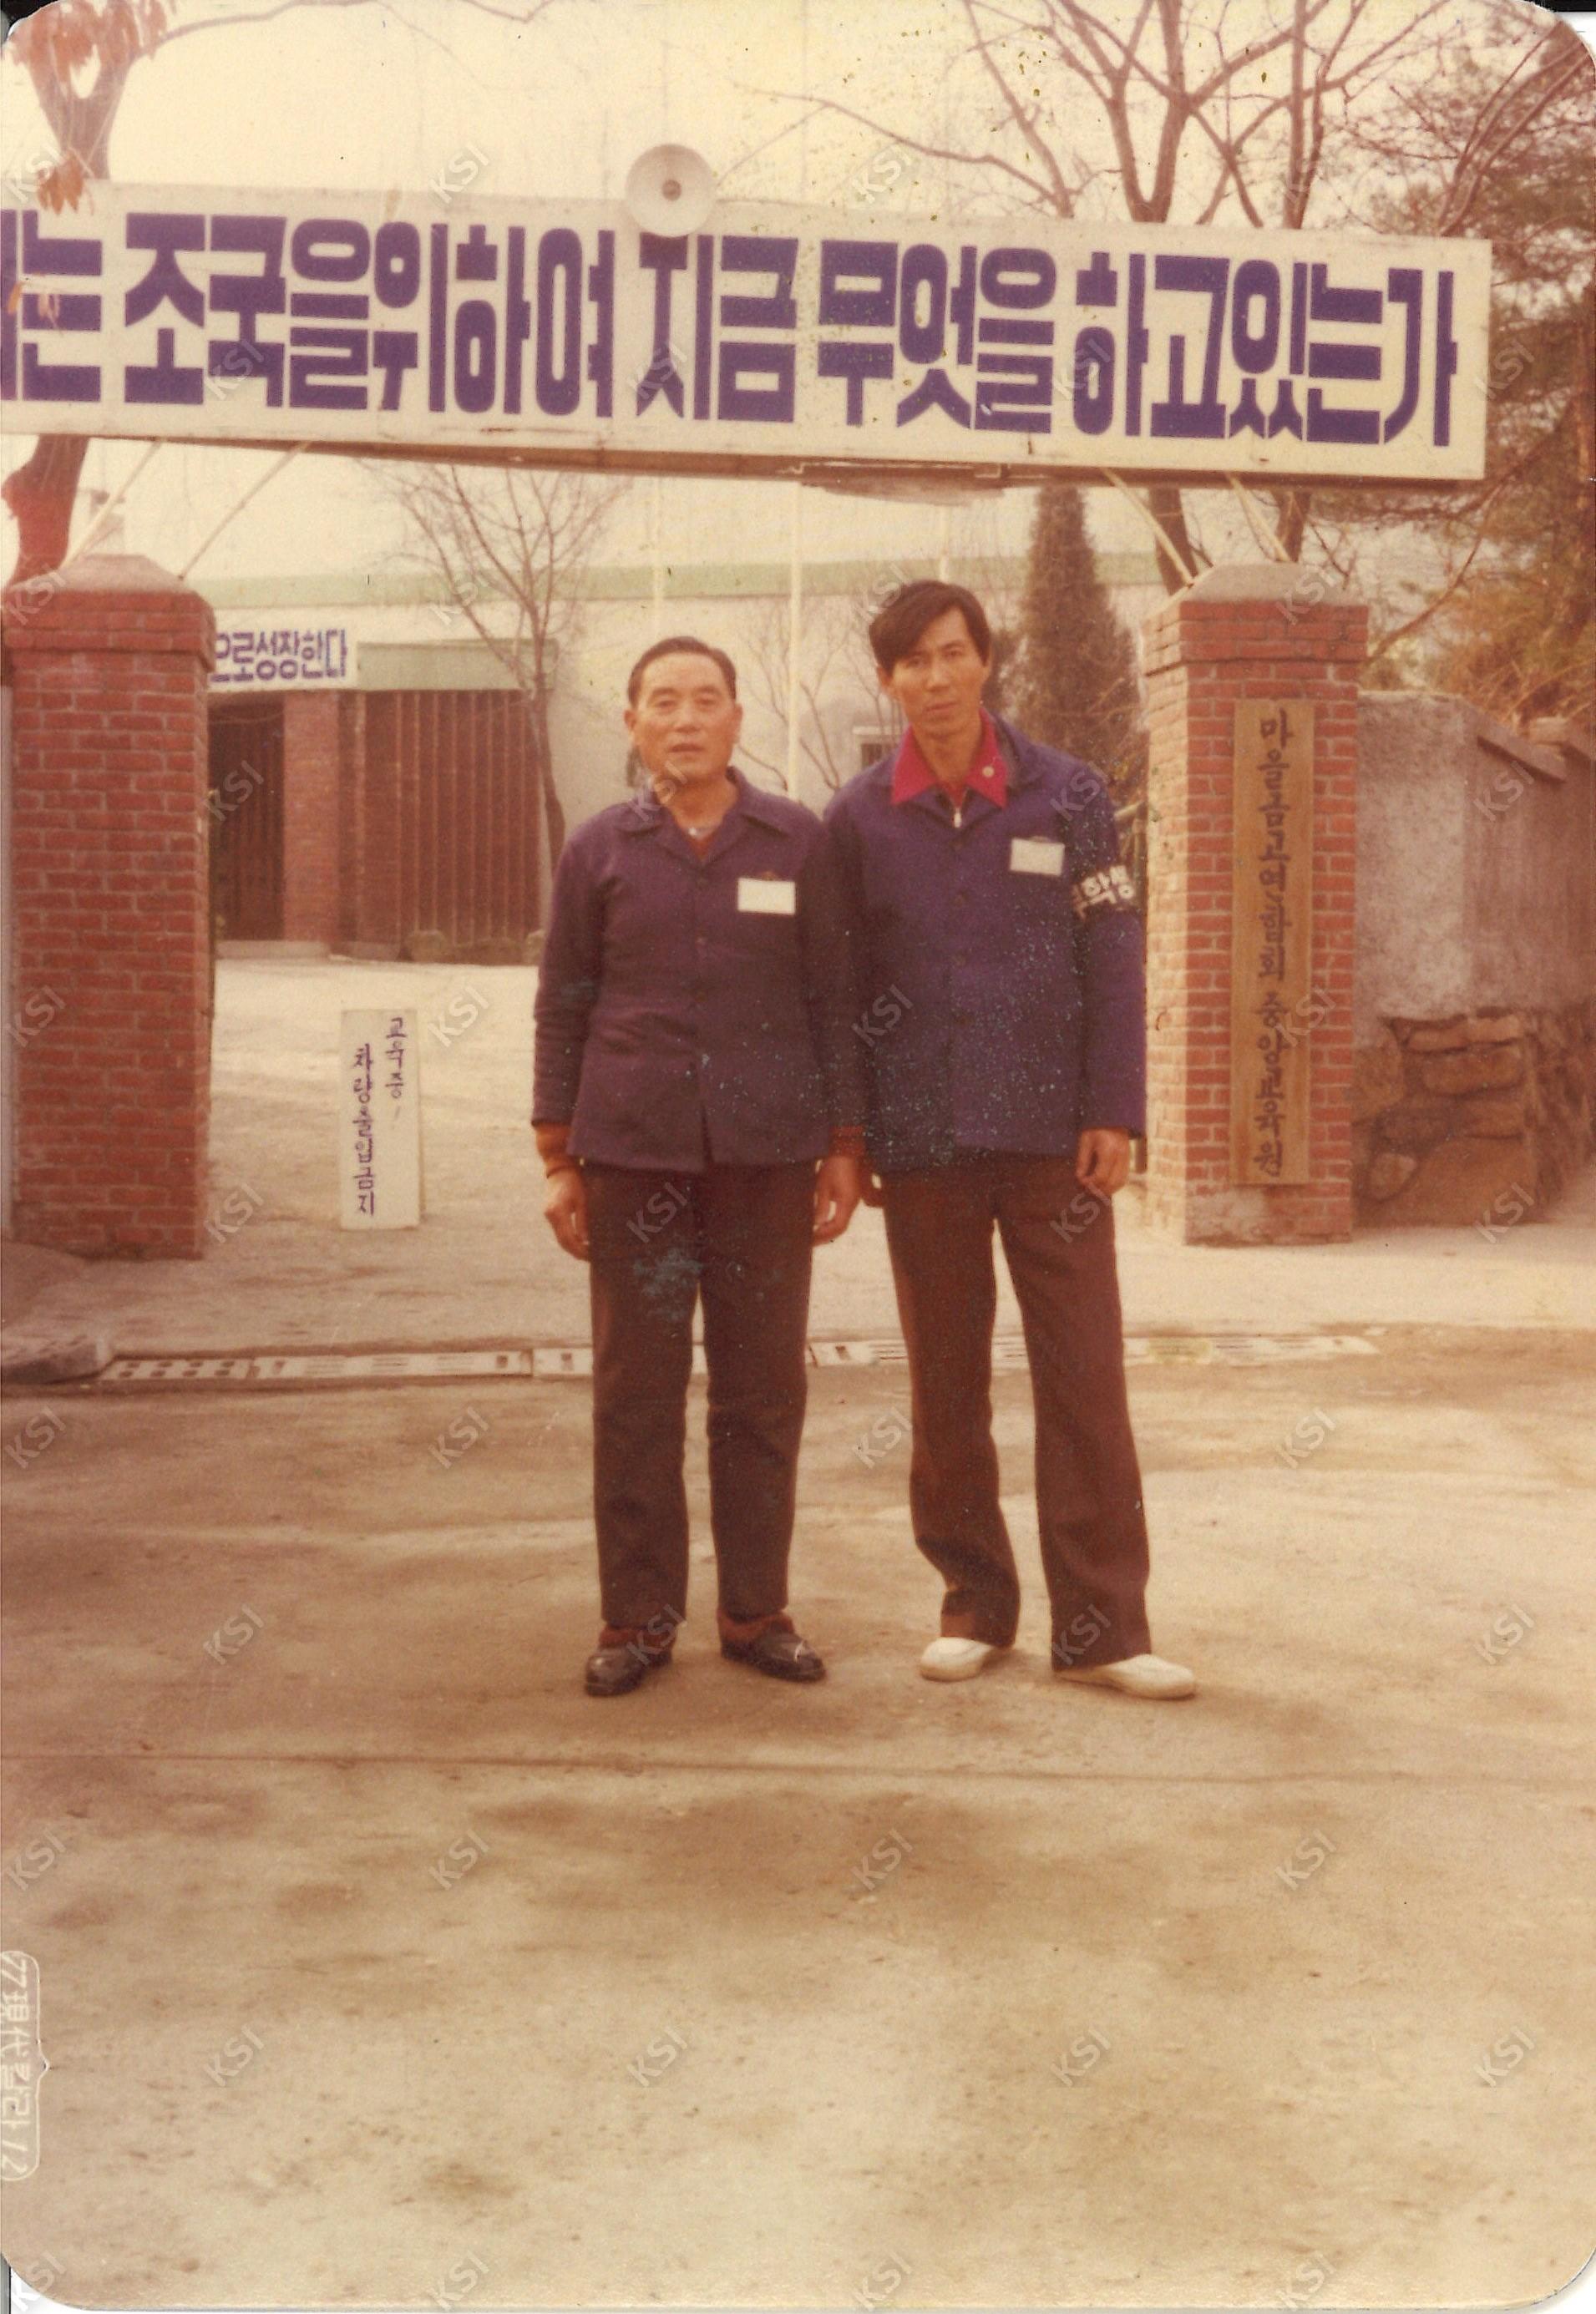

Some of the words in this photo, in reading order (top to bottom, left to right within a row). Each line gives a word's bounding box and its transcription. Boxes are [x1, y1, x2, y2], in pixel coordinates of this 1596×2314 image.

[0, 208, 102, 403] 는
[636, 231, 799, 423] 지금
[817, 239, 1056, 435] 무엇을
[385, 1016, 408, 1099] 교육중
[1254, 991, 1291, 1178] 중앙교육원
